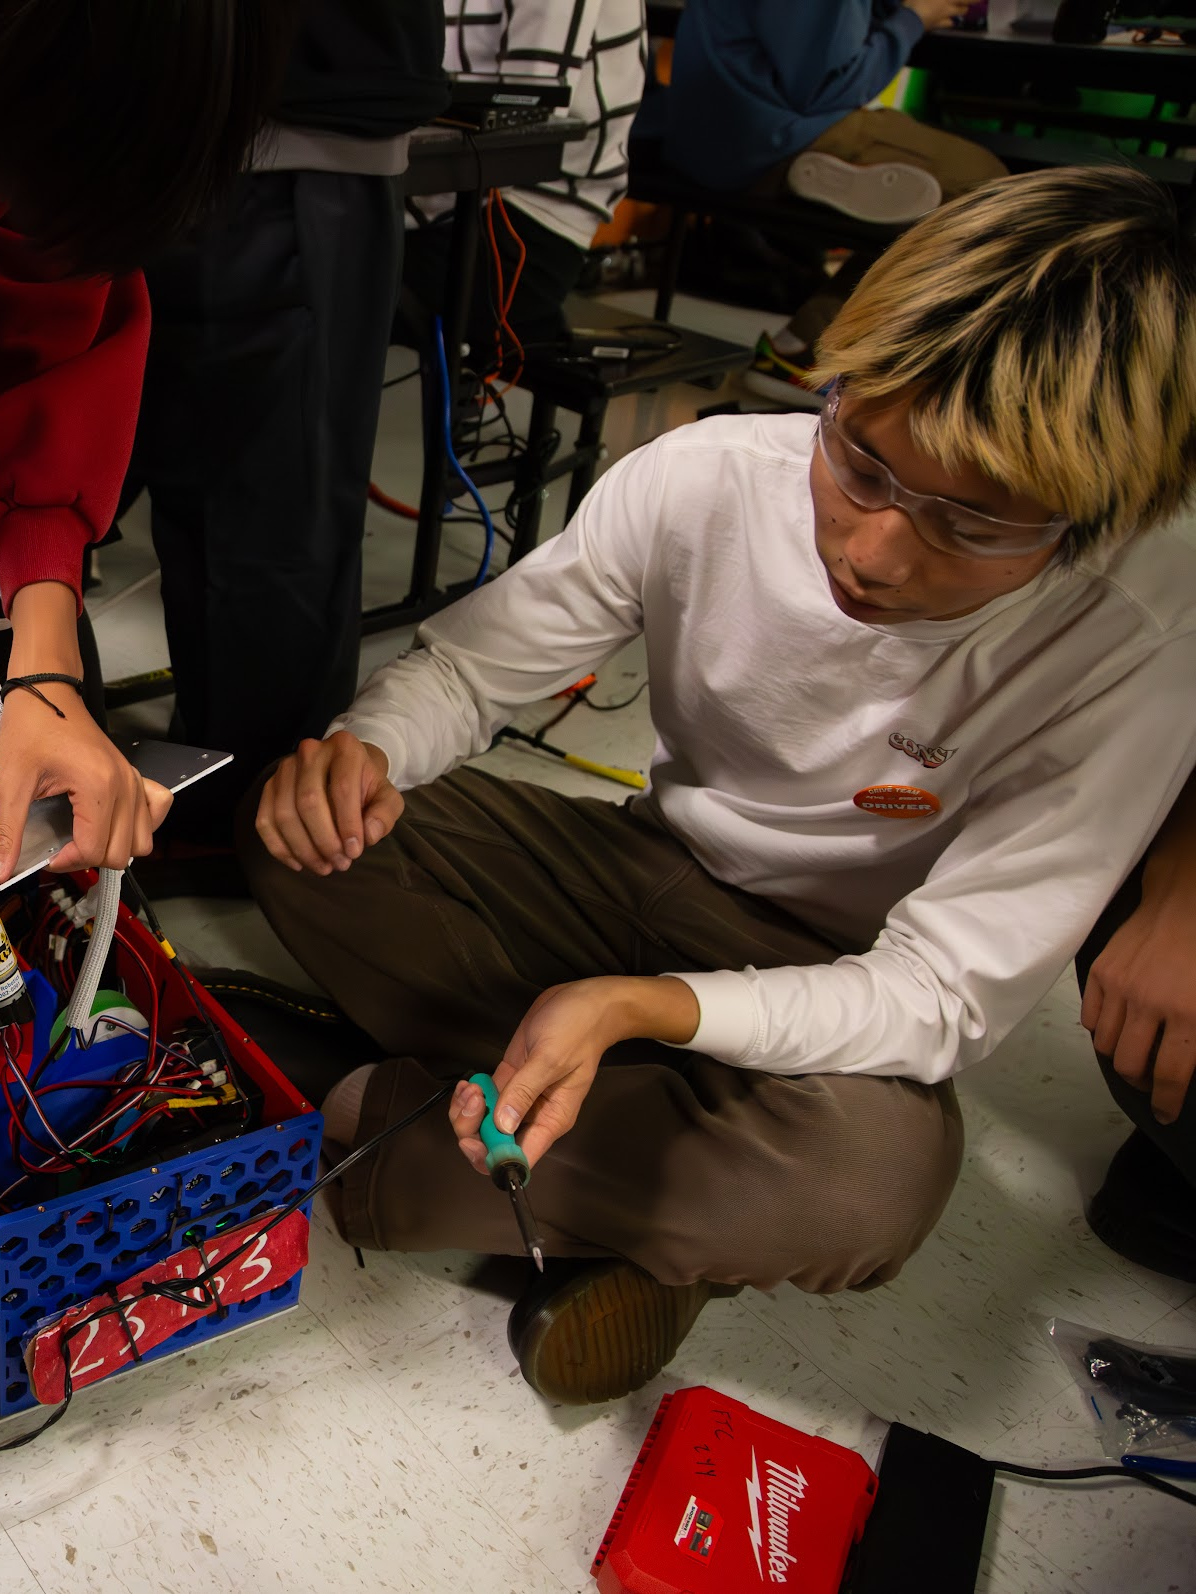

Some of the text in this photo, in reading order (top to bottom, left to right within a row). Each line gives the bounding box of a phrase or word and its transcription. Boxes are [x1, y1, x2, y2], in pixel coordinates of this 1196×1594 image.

[895, 787, 921, 795] TEAM
[862, 802, 932, 811] DRIVER
[711, 1408, 735, 1441] FTC
[764, 1459, 809, 1583] Milwaukee
